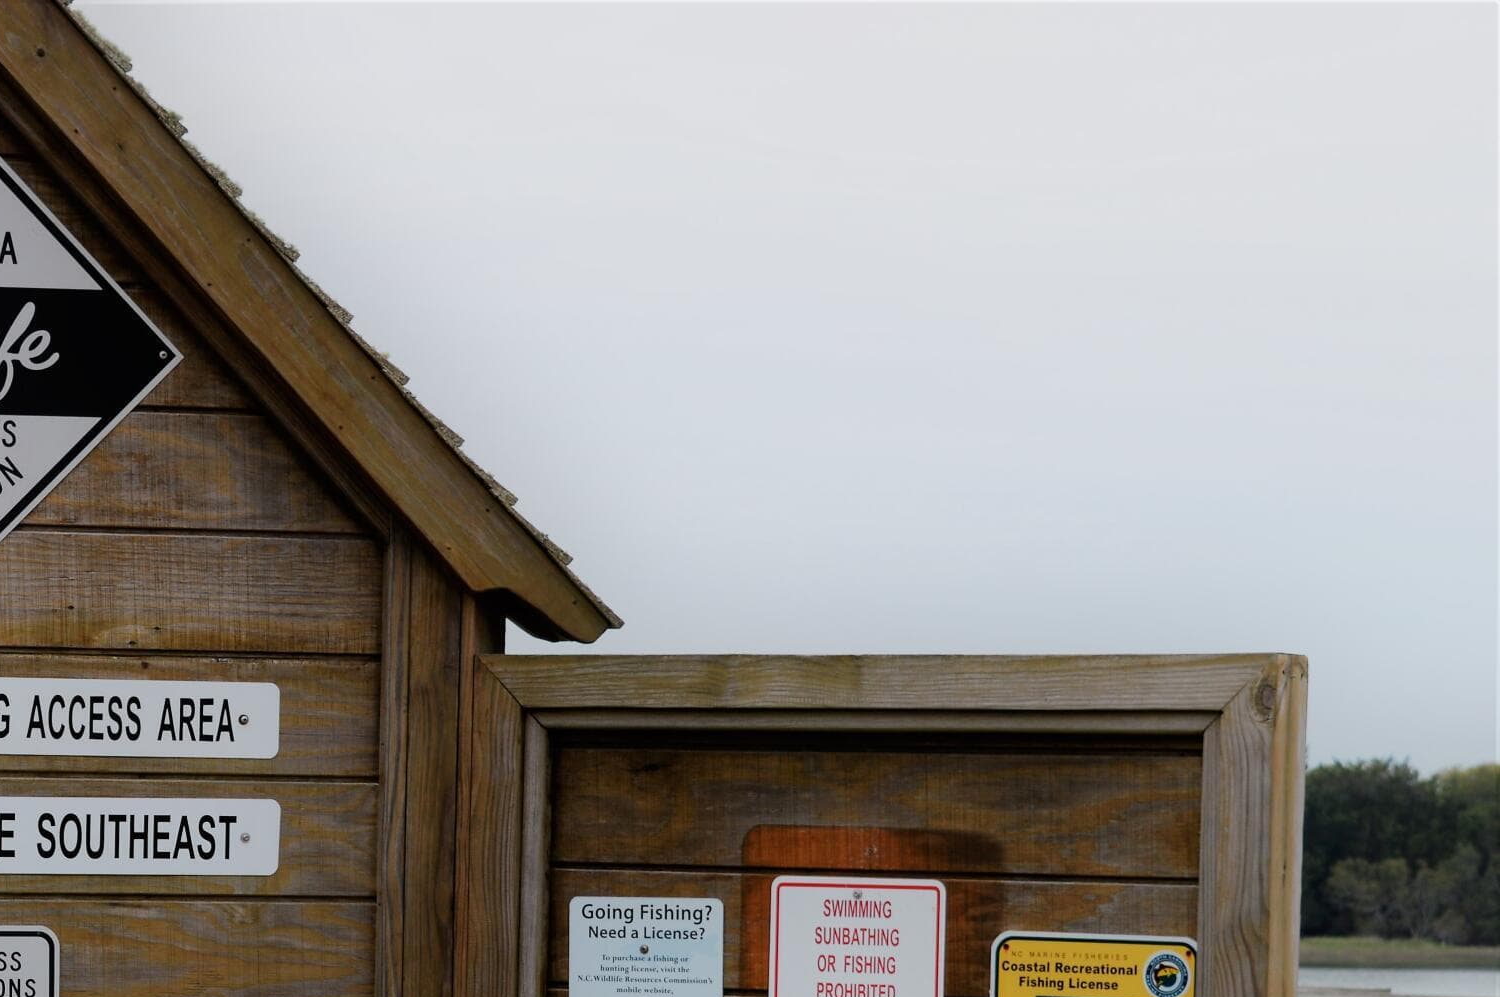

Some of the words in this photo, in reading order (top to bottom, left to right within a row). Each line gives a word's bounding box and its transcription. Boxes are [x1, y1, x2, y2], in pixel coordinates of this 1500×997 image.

[26, 695, 142, 741] ACCESS
[158, 699, 235, 742] AREA
[36, 812, 237, 860] SOUTHEAST
[582, 904, 634, 923] Going
[640, 905, 712, 924] Fishing?
[823, 899, 892, 918] SWIMMING
[588, 926, 626, 939] Need
[632, 928, 638, 939] a
[644, 927, 705, 940] License?
[815, 927, 900, 946] SUNBATHING
[613, 955, 645, 963] purchase
[653, 955, 678, 964] fishing
[817, 955, 836, 972] OR
[844, 956, 896, 974] FISHING
[1002, 961, 1050, 973] Coastal
[1055, 963, 1137, 976] Recreational
[600, 965, 629, 974] hunting
[1019, 977, 1064, 990] Fishing
[1069, 978, 1118, 990] License
